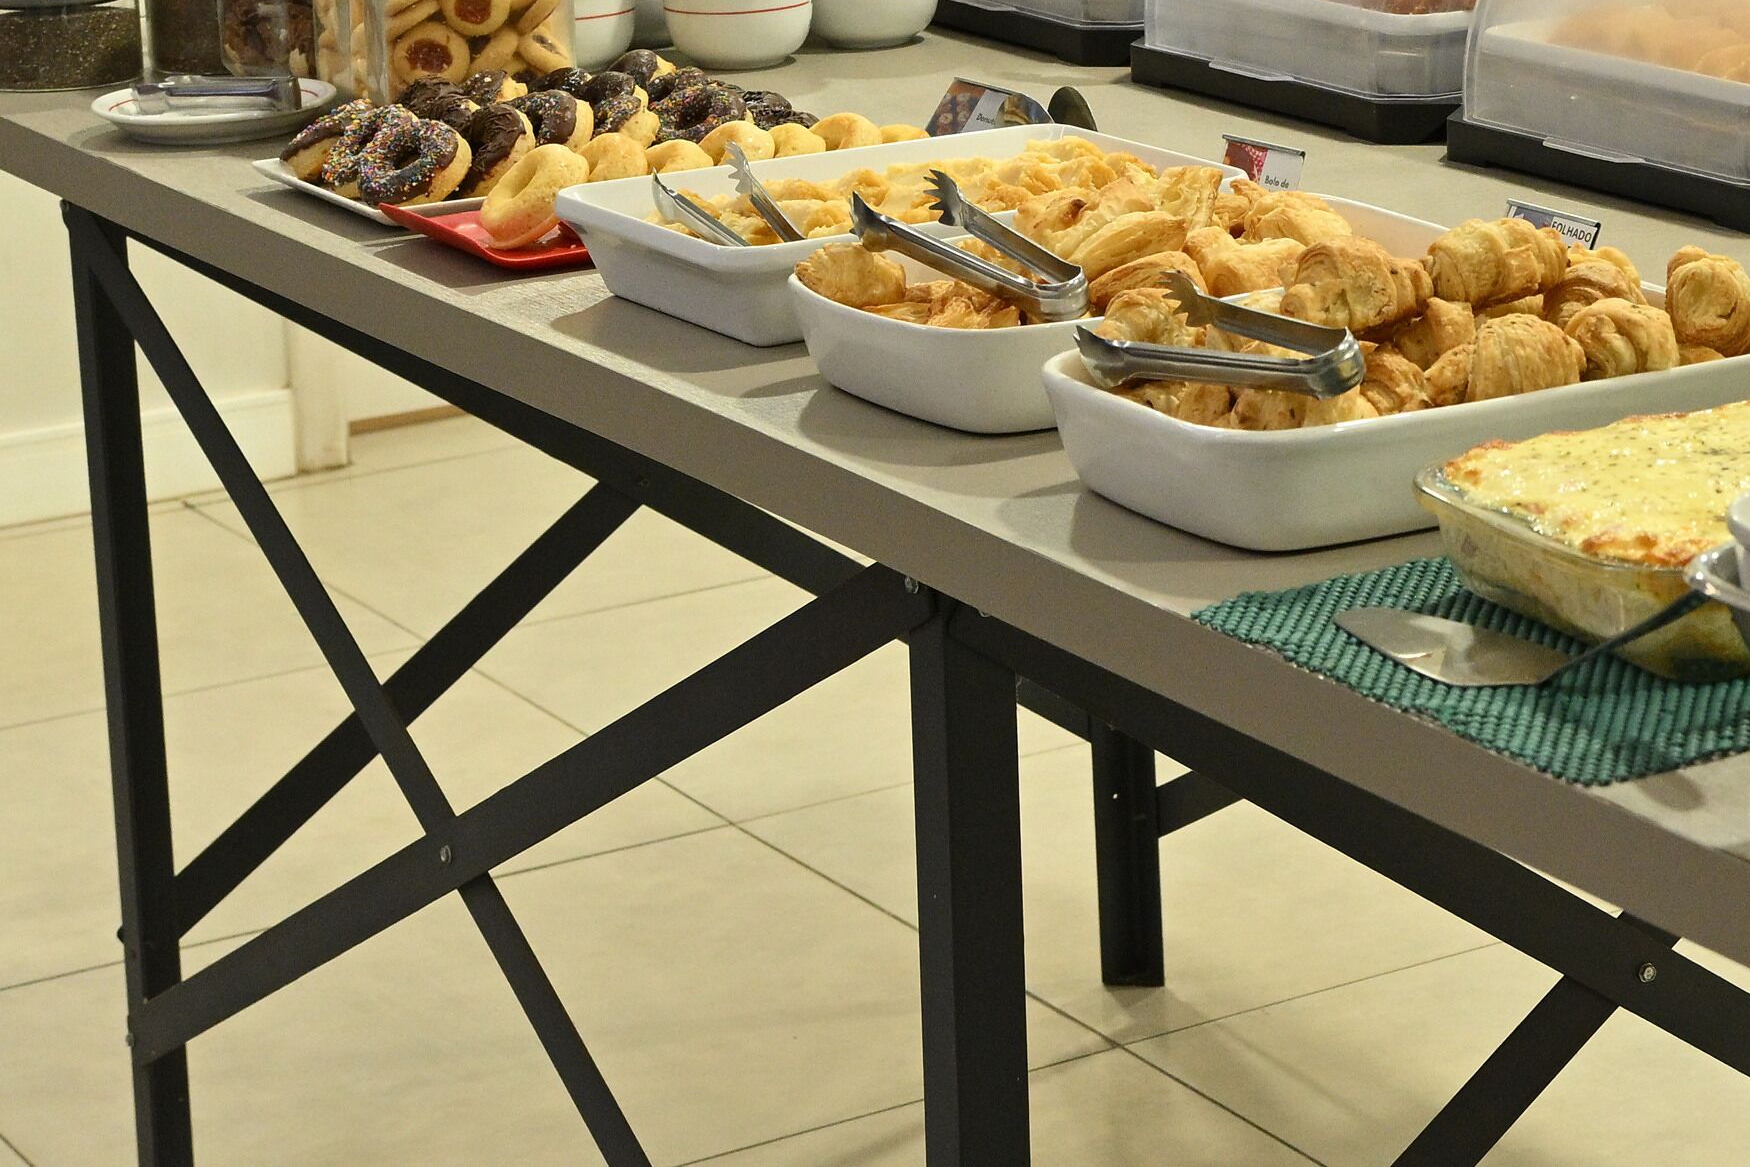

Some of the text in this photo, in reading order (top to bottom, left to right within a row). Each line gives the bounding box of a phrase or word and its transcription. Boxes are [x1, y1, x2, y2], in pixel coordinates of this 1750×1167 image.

[1264, 175, 1290, 189] Bolo de
[1552, 221, 1592, 242] FOLHADO
